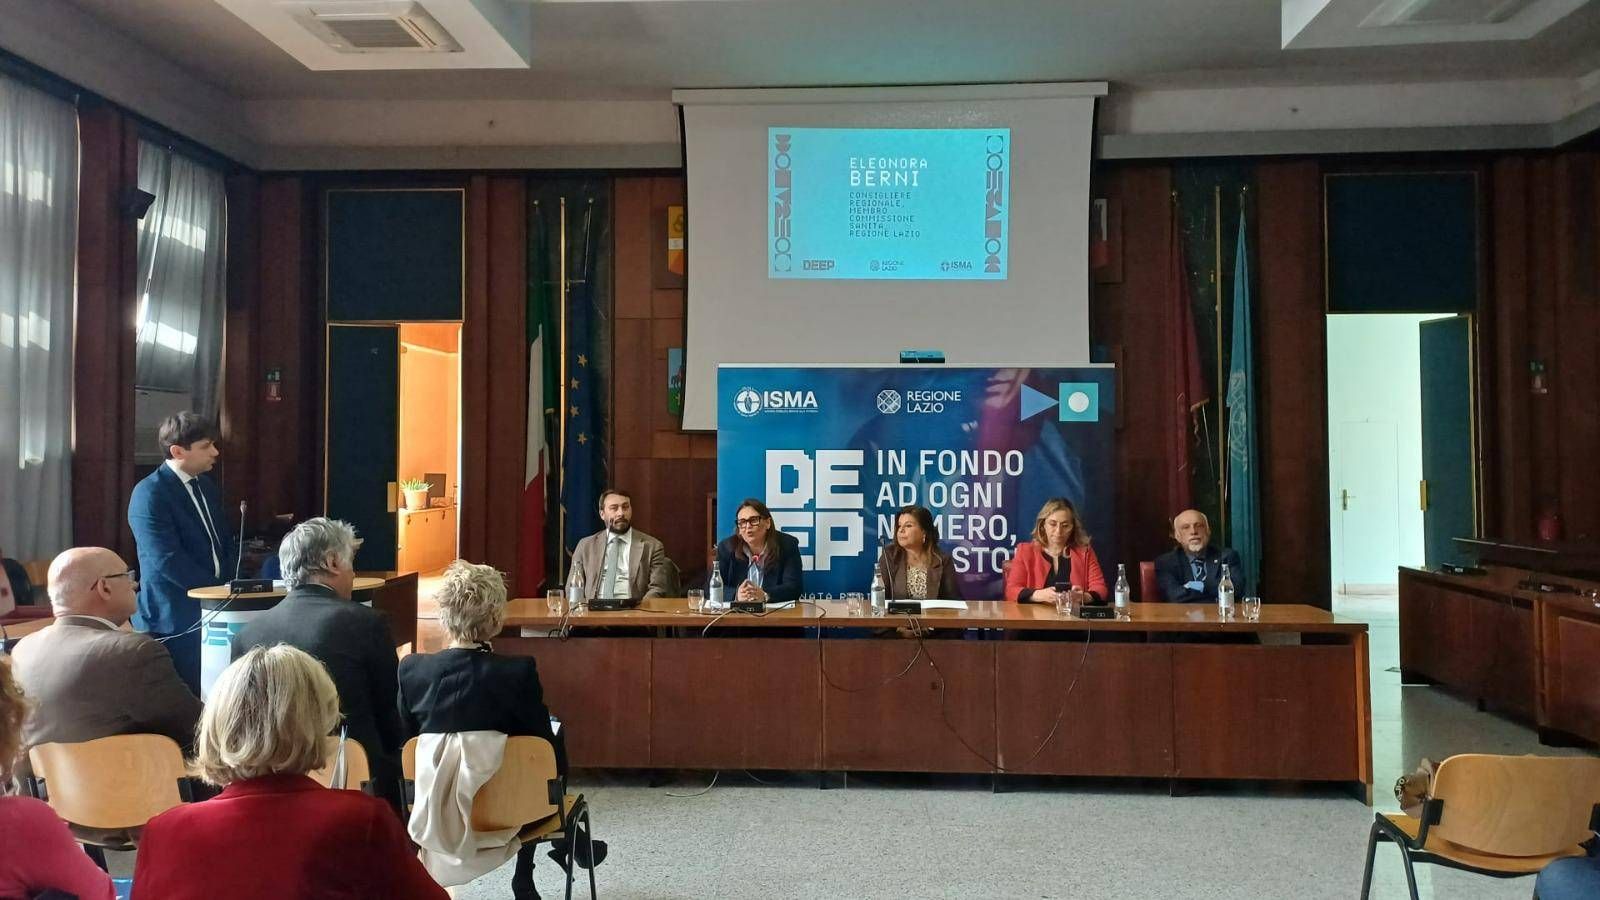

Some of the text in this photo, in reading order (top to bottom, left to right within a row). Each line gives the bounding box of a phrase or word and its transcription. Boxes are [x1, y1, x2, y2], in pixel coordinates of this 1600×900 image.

[850, 157, 928, 169] ELEONORA
[850, 170, 919, 186] BERNI
[849, 191, 912, 200] CONSIGLIERE
[849, 207, 888, 215] MEMBRO
[849, 214, 915, 223] COMMISSIONE
[849, 230, 921, 238] REGIONE LAZIO
[803, 259, 835, 271] DEEP
[951, 261, 973, 270] ISMA
[763, 390, 819, 408] ISMA
[906, 390, 962, 402] REGIONE
[906, 402, 944, 413] LAZIO
[877, 449, 1024, 477] IN FONDO
[765, 449, 864, 509] DE
[875, 481, 1003, 508] AD OGNI
[877, 513, 1017, 546] NERO,
[951, 546, 1018, 574] STO
